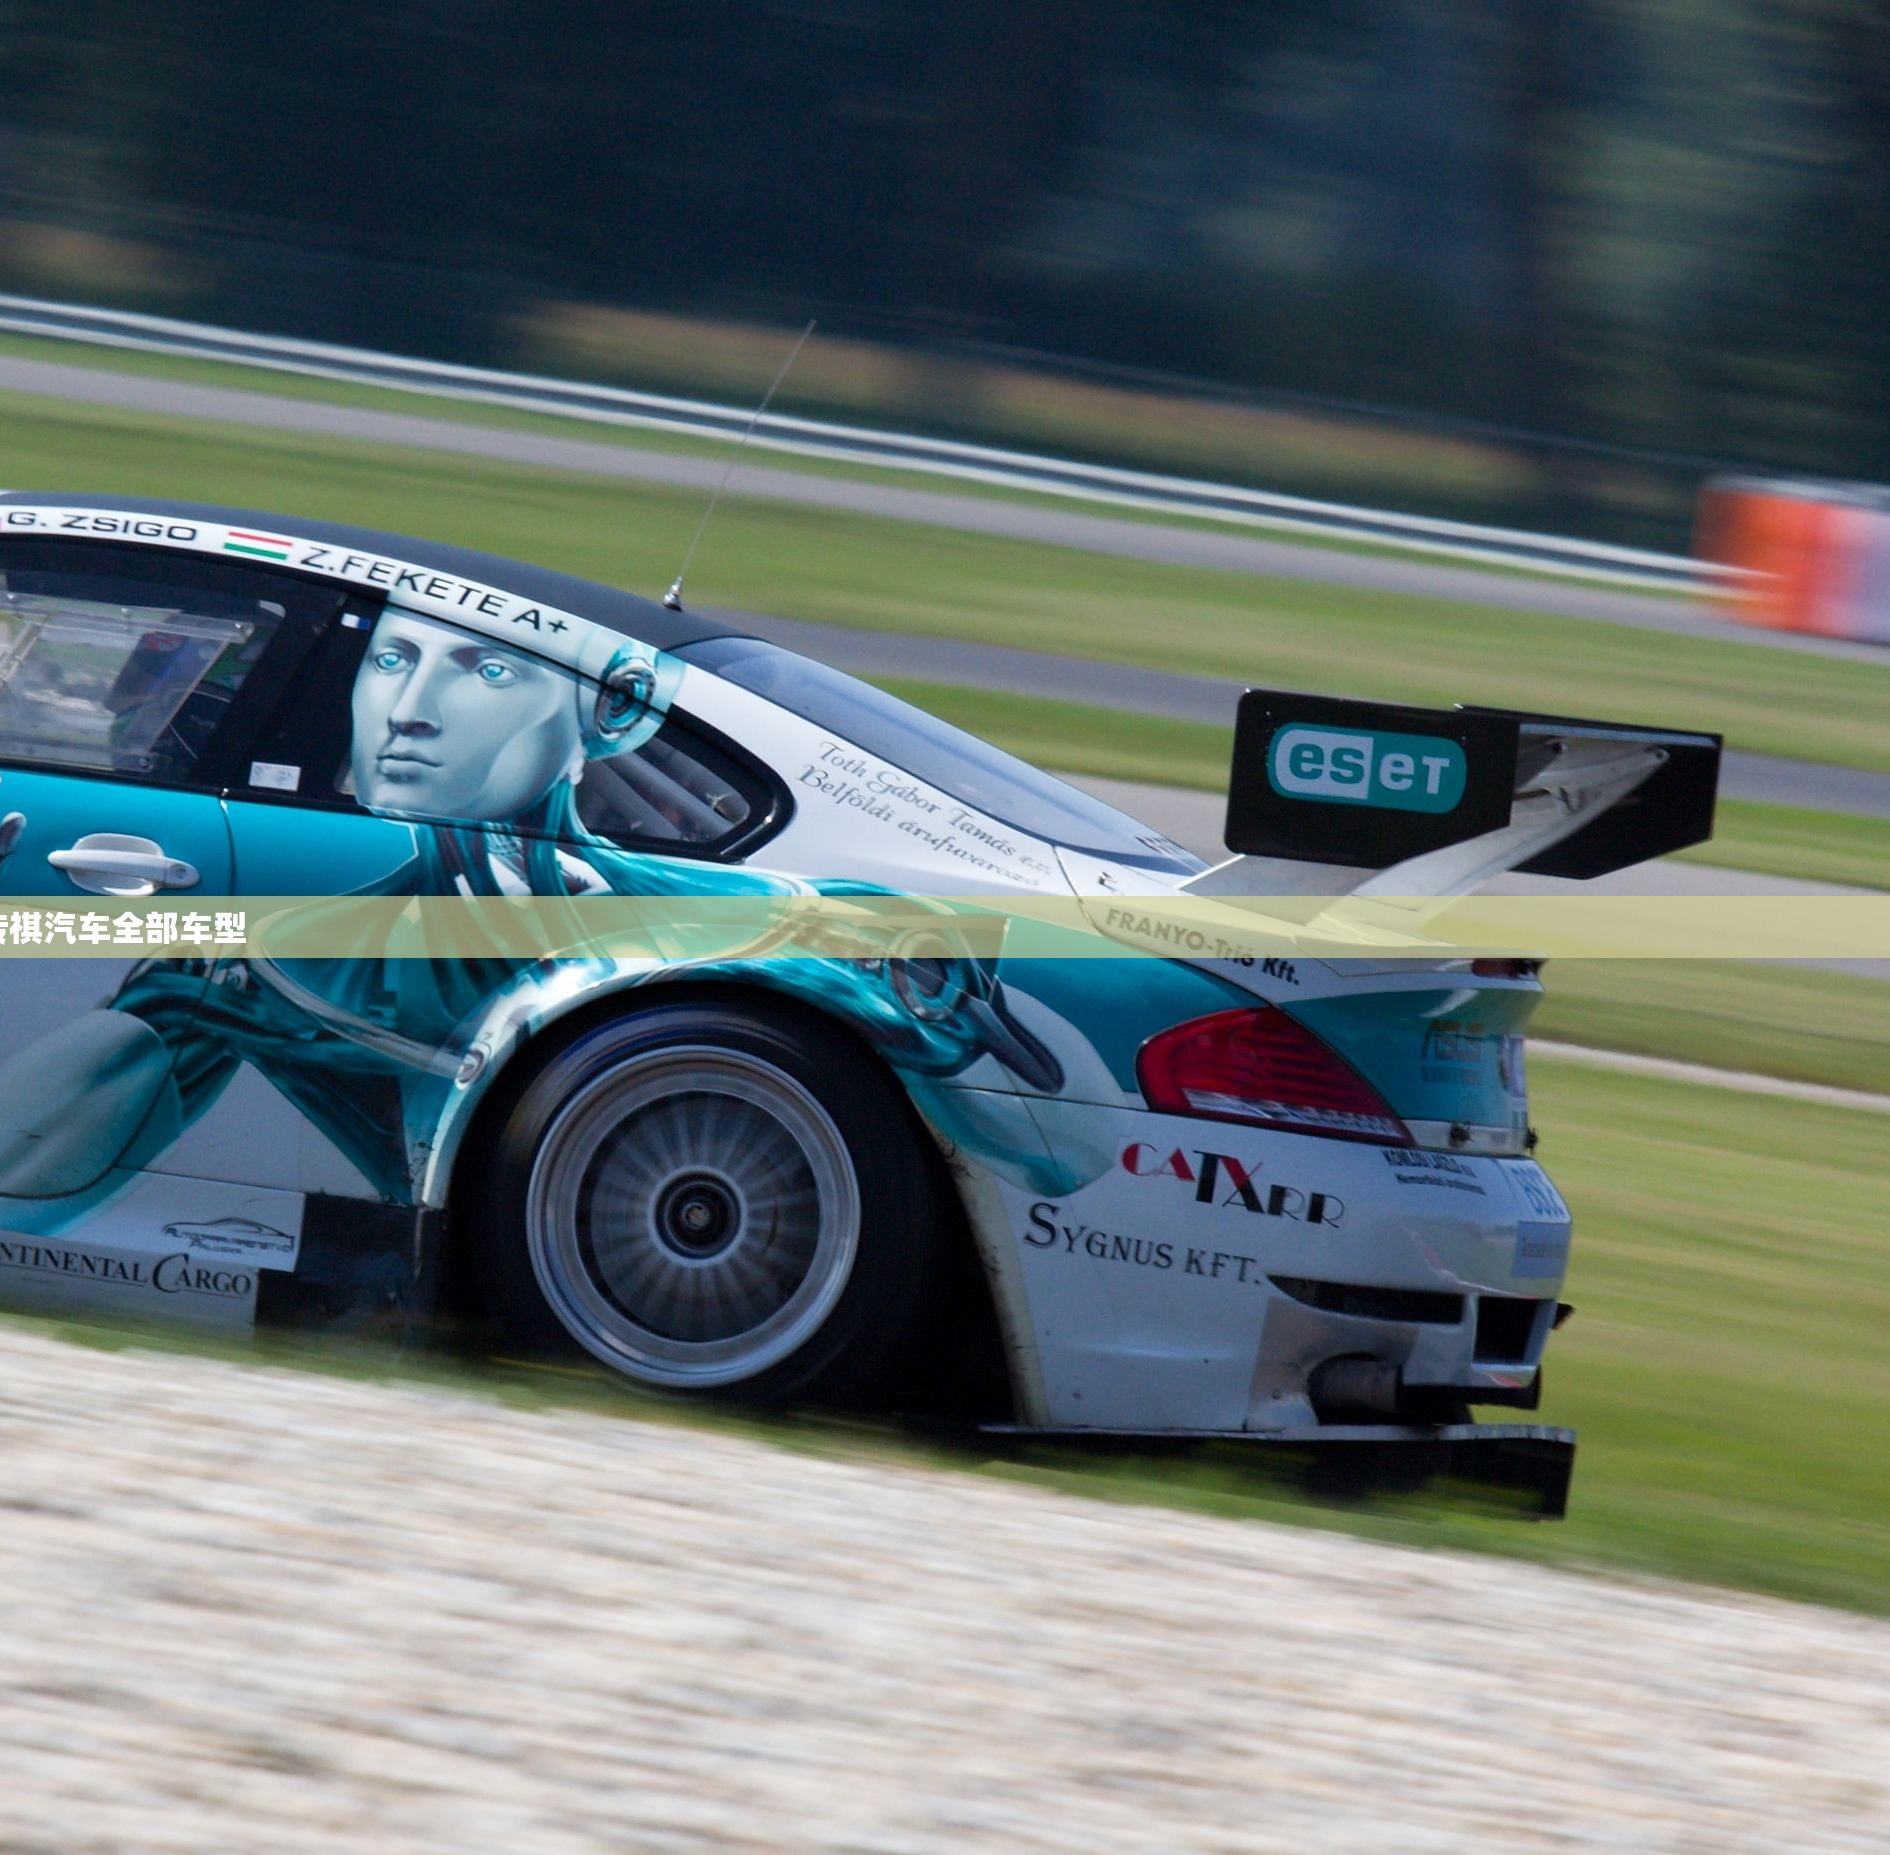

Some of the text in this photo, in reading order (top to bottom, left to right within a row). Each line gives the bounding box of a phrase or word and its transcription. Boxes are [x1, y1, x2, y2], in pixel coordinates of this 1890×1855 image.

[7, 511, 198, 542] G. ZSIGO
[300, 546, 570, 634] Z.FEKETE A+
[1262, 954, 1300, 986] Kft.
[1023, 1201, 1261, 1285] SYGNUS KFT.
[152, 1253, 252, 1295] CARGO
